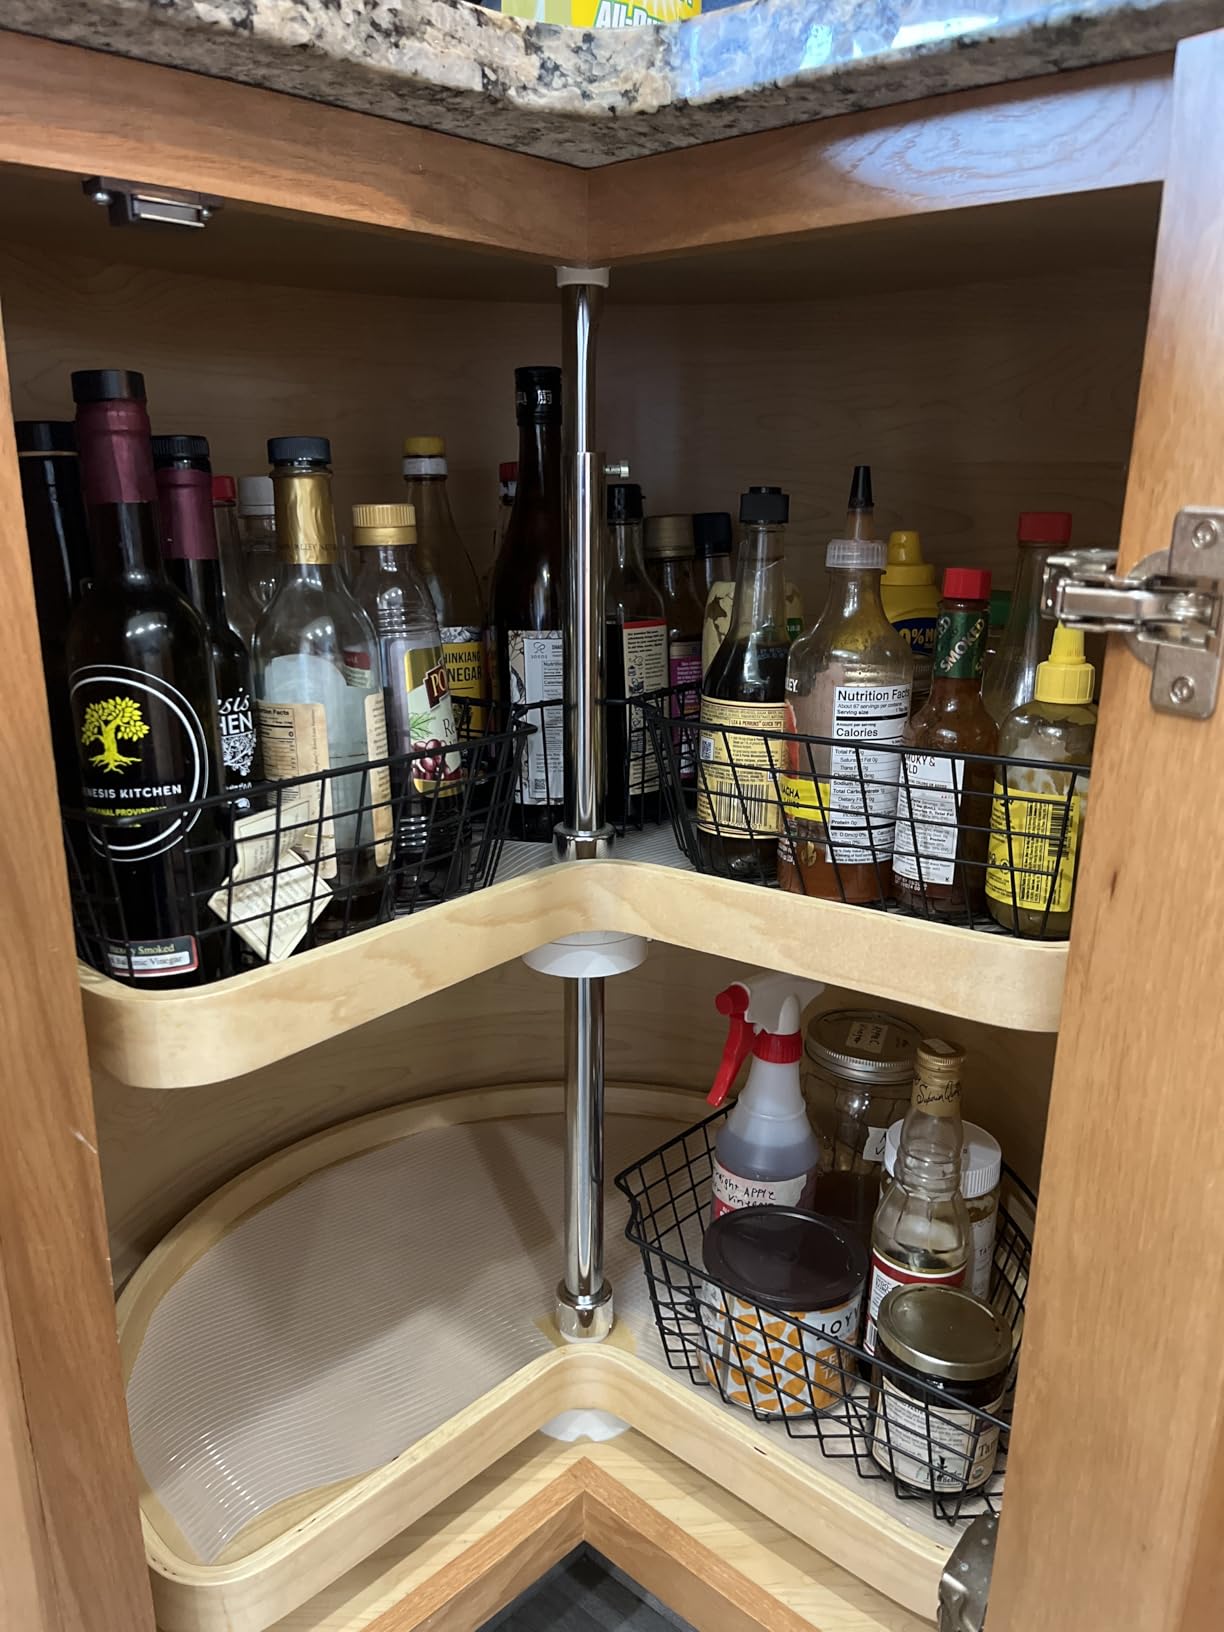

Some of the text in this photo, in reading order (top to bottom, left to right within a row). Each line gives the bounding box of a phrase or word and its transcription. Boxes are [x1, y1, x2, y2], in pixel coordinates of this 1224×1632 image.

[940, 619, 984, 672] SMOKED
[838, 687, 910, 702] Nutrition Facts
[836, 728, 878, 737] Calories
[119, 784, 182, 799] KITCHEN
[137, 943, 176, 955] Smoked
